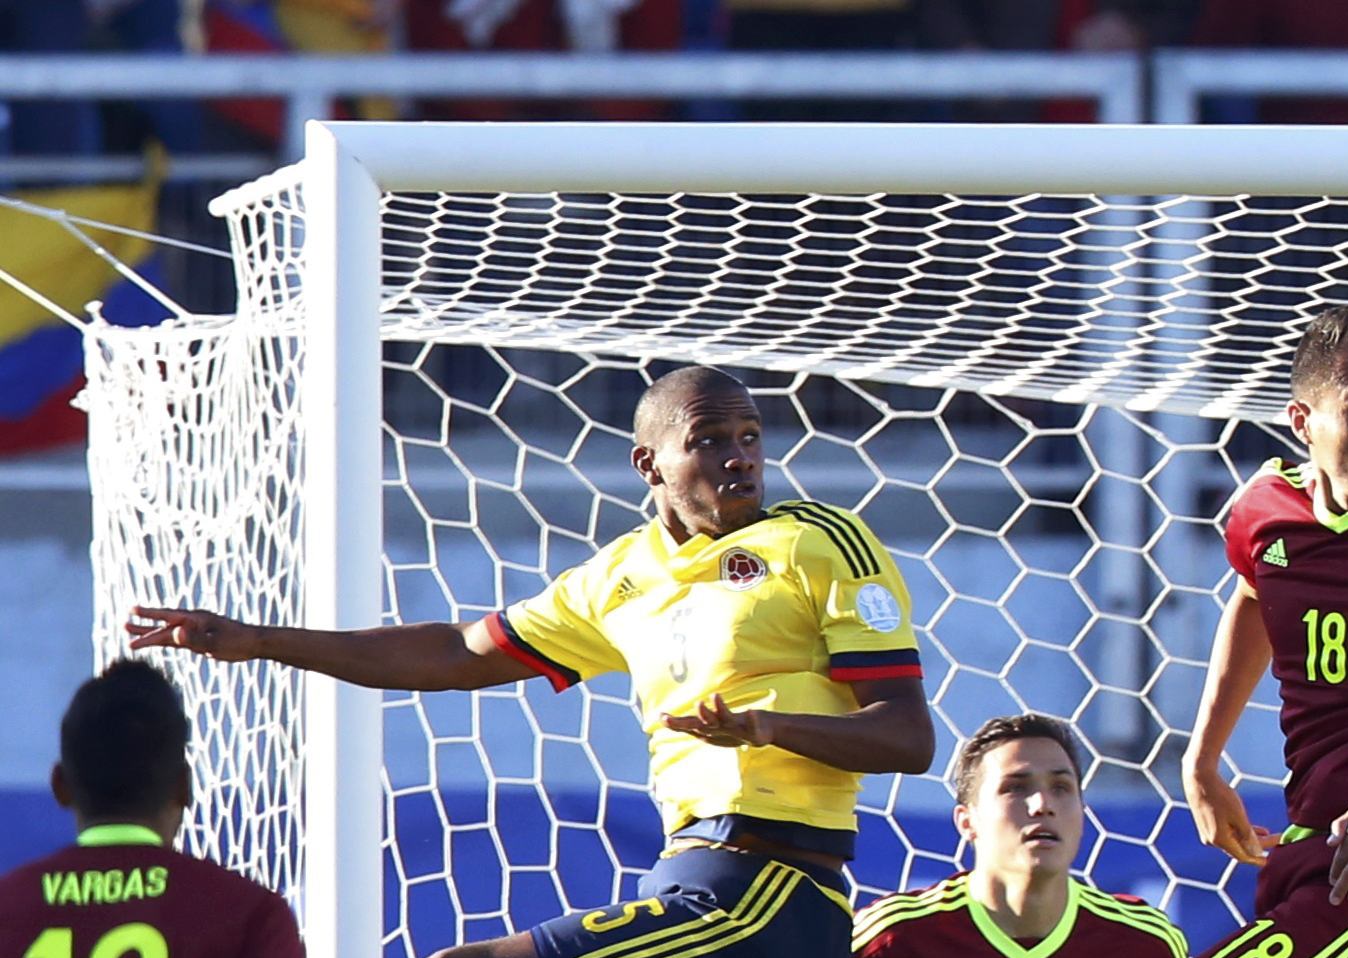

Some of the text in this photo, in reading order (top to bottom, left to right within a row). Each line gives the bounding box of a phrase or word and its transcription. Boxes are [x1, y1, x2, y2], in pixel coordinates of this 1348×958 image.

[1302, 609, 1346, 684] 18
[42, 867, 168, 906] VARGAS
[581, 897, 665, 932] 5
